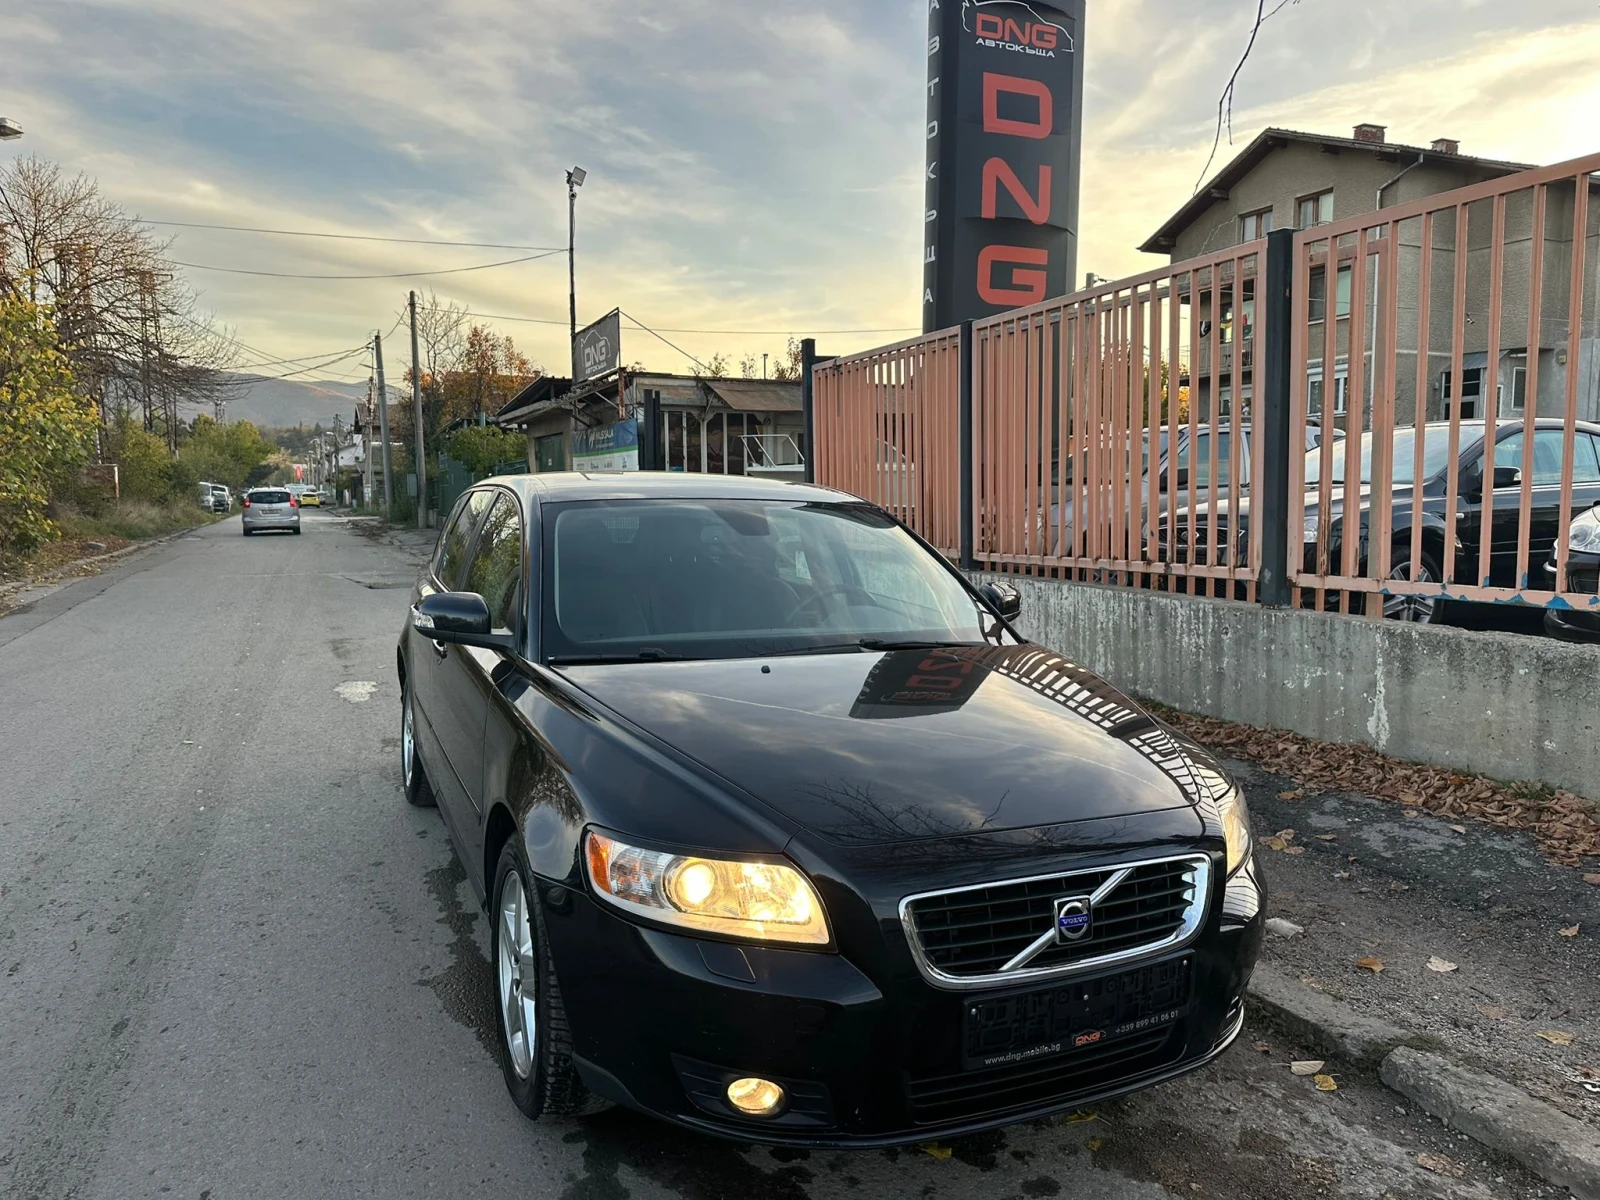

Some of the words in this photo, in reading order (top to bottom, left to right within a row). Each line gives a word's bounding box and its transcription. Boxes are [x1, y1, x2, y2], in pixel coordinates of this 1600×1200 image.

[976, 12, 1057, 49] DNG
[977, 71, 1053, 306] DNG
[584, 340, 606, 368] DNG
[1062, 916, 1088, 925] VOLVO
[1115, 1023, 1134, 1034] +359
[1135, 1018, 1149, 1029] 899
[1150, 1016, 1159, 1024] 41
[1170, 1010, 1178, 1018] 01
[1075, 1031, 1101, 1045] DNG
[984, 1043, 1061, 1065] www.dng.mobile.bg
